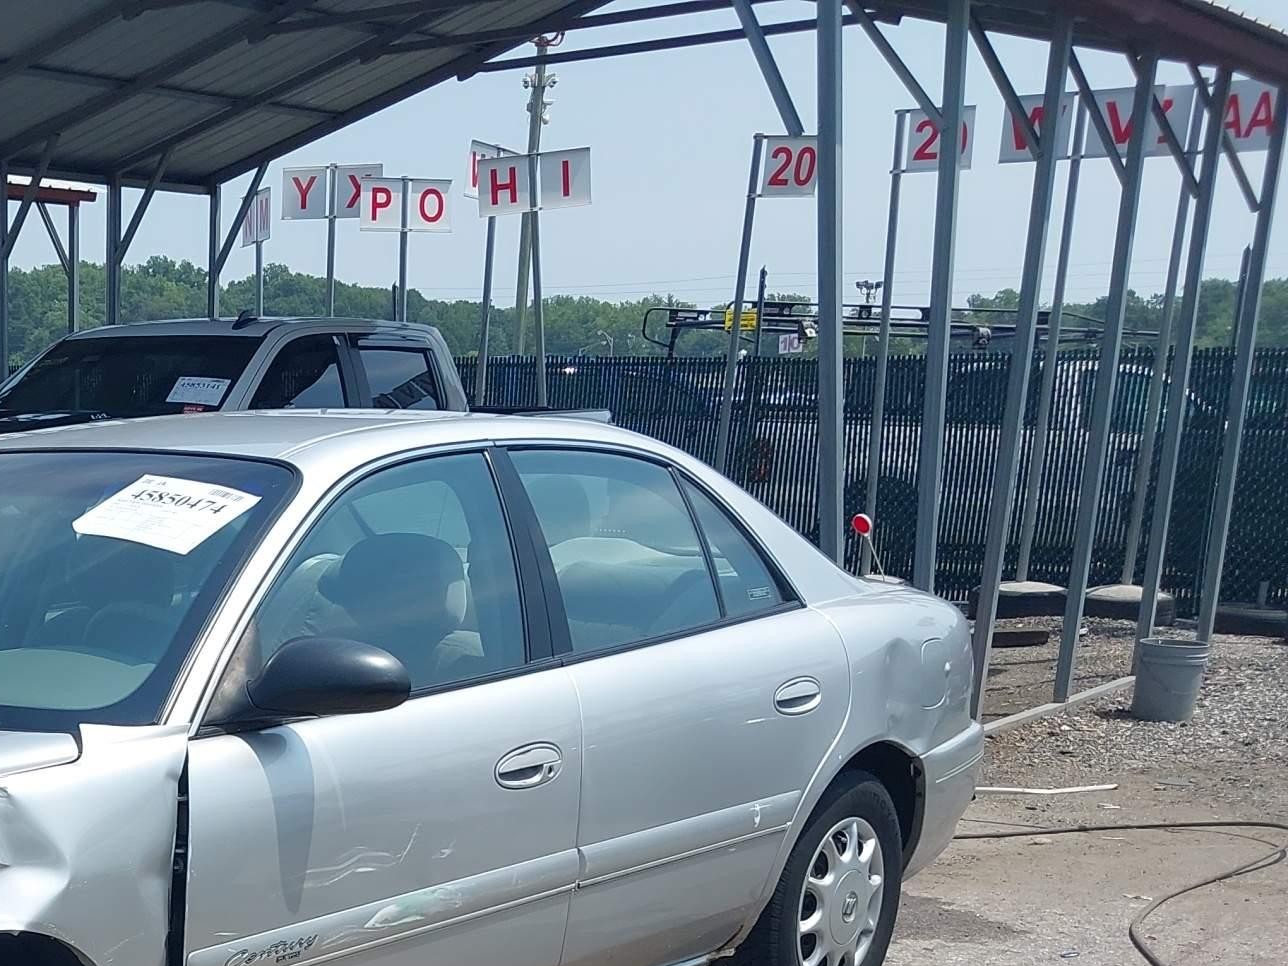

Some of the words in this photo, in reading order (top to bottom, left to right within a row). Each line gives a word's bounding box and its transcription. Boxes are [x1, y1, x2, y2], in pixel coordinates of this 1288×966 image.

[1223, 91, 1276, 138] AA
[490, 166, 517, 205] H
[562, 160, 570, 197] I
[768, 146, 816, 186] 20
[292, 175, 317, 210] Y
[371, 187, 392, 221] P
[419, 188, 444, 222] O
[259, 197, 269, 233] M
[131, 489, 228, 515] 45850474
